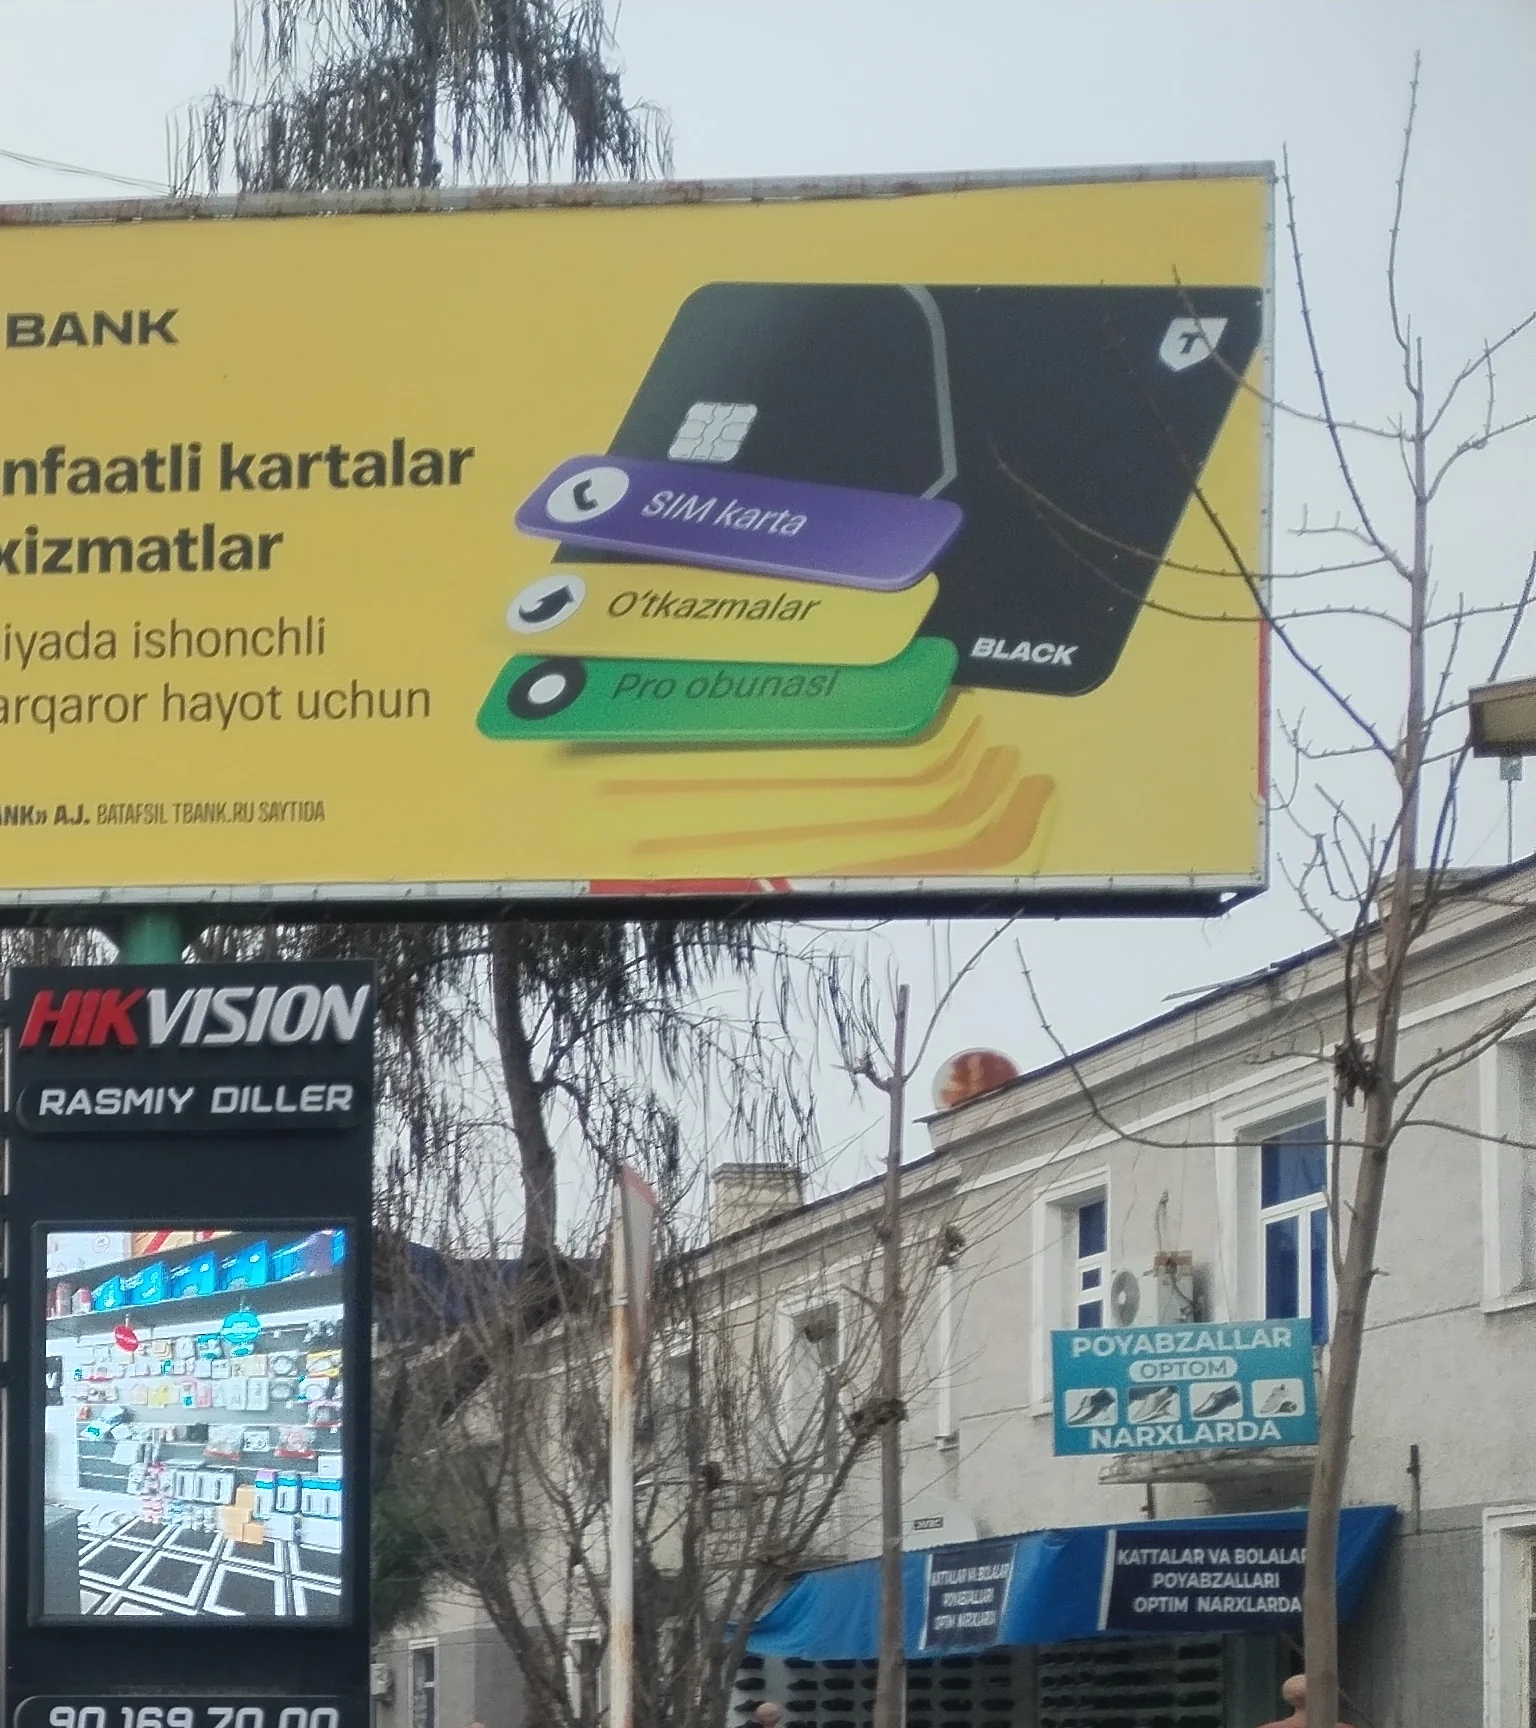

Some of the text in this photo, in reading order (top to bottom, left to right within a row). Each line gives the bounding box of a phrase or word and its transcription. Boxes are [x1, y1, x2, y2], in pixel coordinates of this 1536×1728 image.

[5, 307, 180, 350] BANK
[218, 437, 476, 494] kartalar
[640, 489, 808, 538] SIM karta
[132, 615, 327, 661] ishonchli
[970, 636, 1080, 667] BLACK
[611, 668, 842, 700] Pro obunasi
[161, 681, 284, 732] hayot
[296, 678, 432, 723] uchun
[96, 801, 169, 825] BATAFSIL
[171, 800, 255, 825] TBANK.RU
[257, 799, 327, 823] SAYTIDA
[18, 983, 371, 1050] HIKVISION
[38, 1083, 354, 1117] RASMIY DILLER
[1070, 1326, 1293, 1358] POYABZALLAR
[1139, 1359, 1228, 1380] OPTOM
[1089, 1419, 1282, 1450] NARXLARDA
[1116, 1548, 1205, 1566] KATTALAR
[1207, 1548, 1232, 1565] VA
[1151, 1572, 1281, 1590] POYABZALLARI
[1132, 1596, 1304, 1614] OPTIM NARXLARDA
